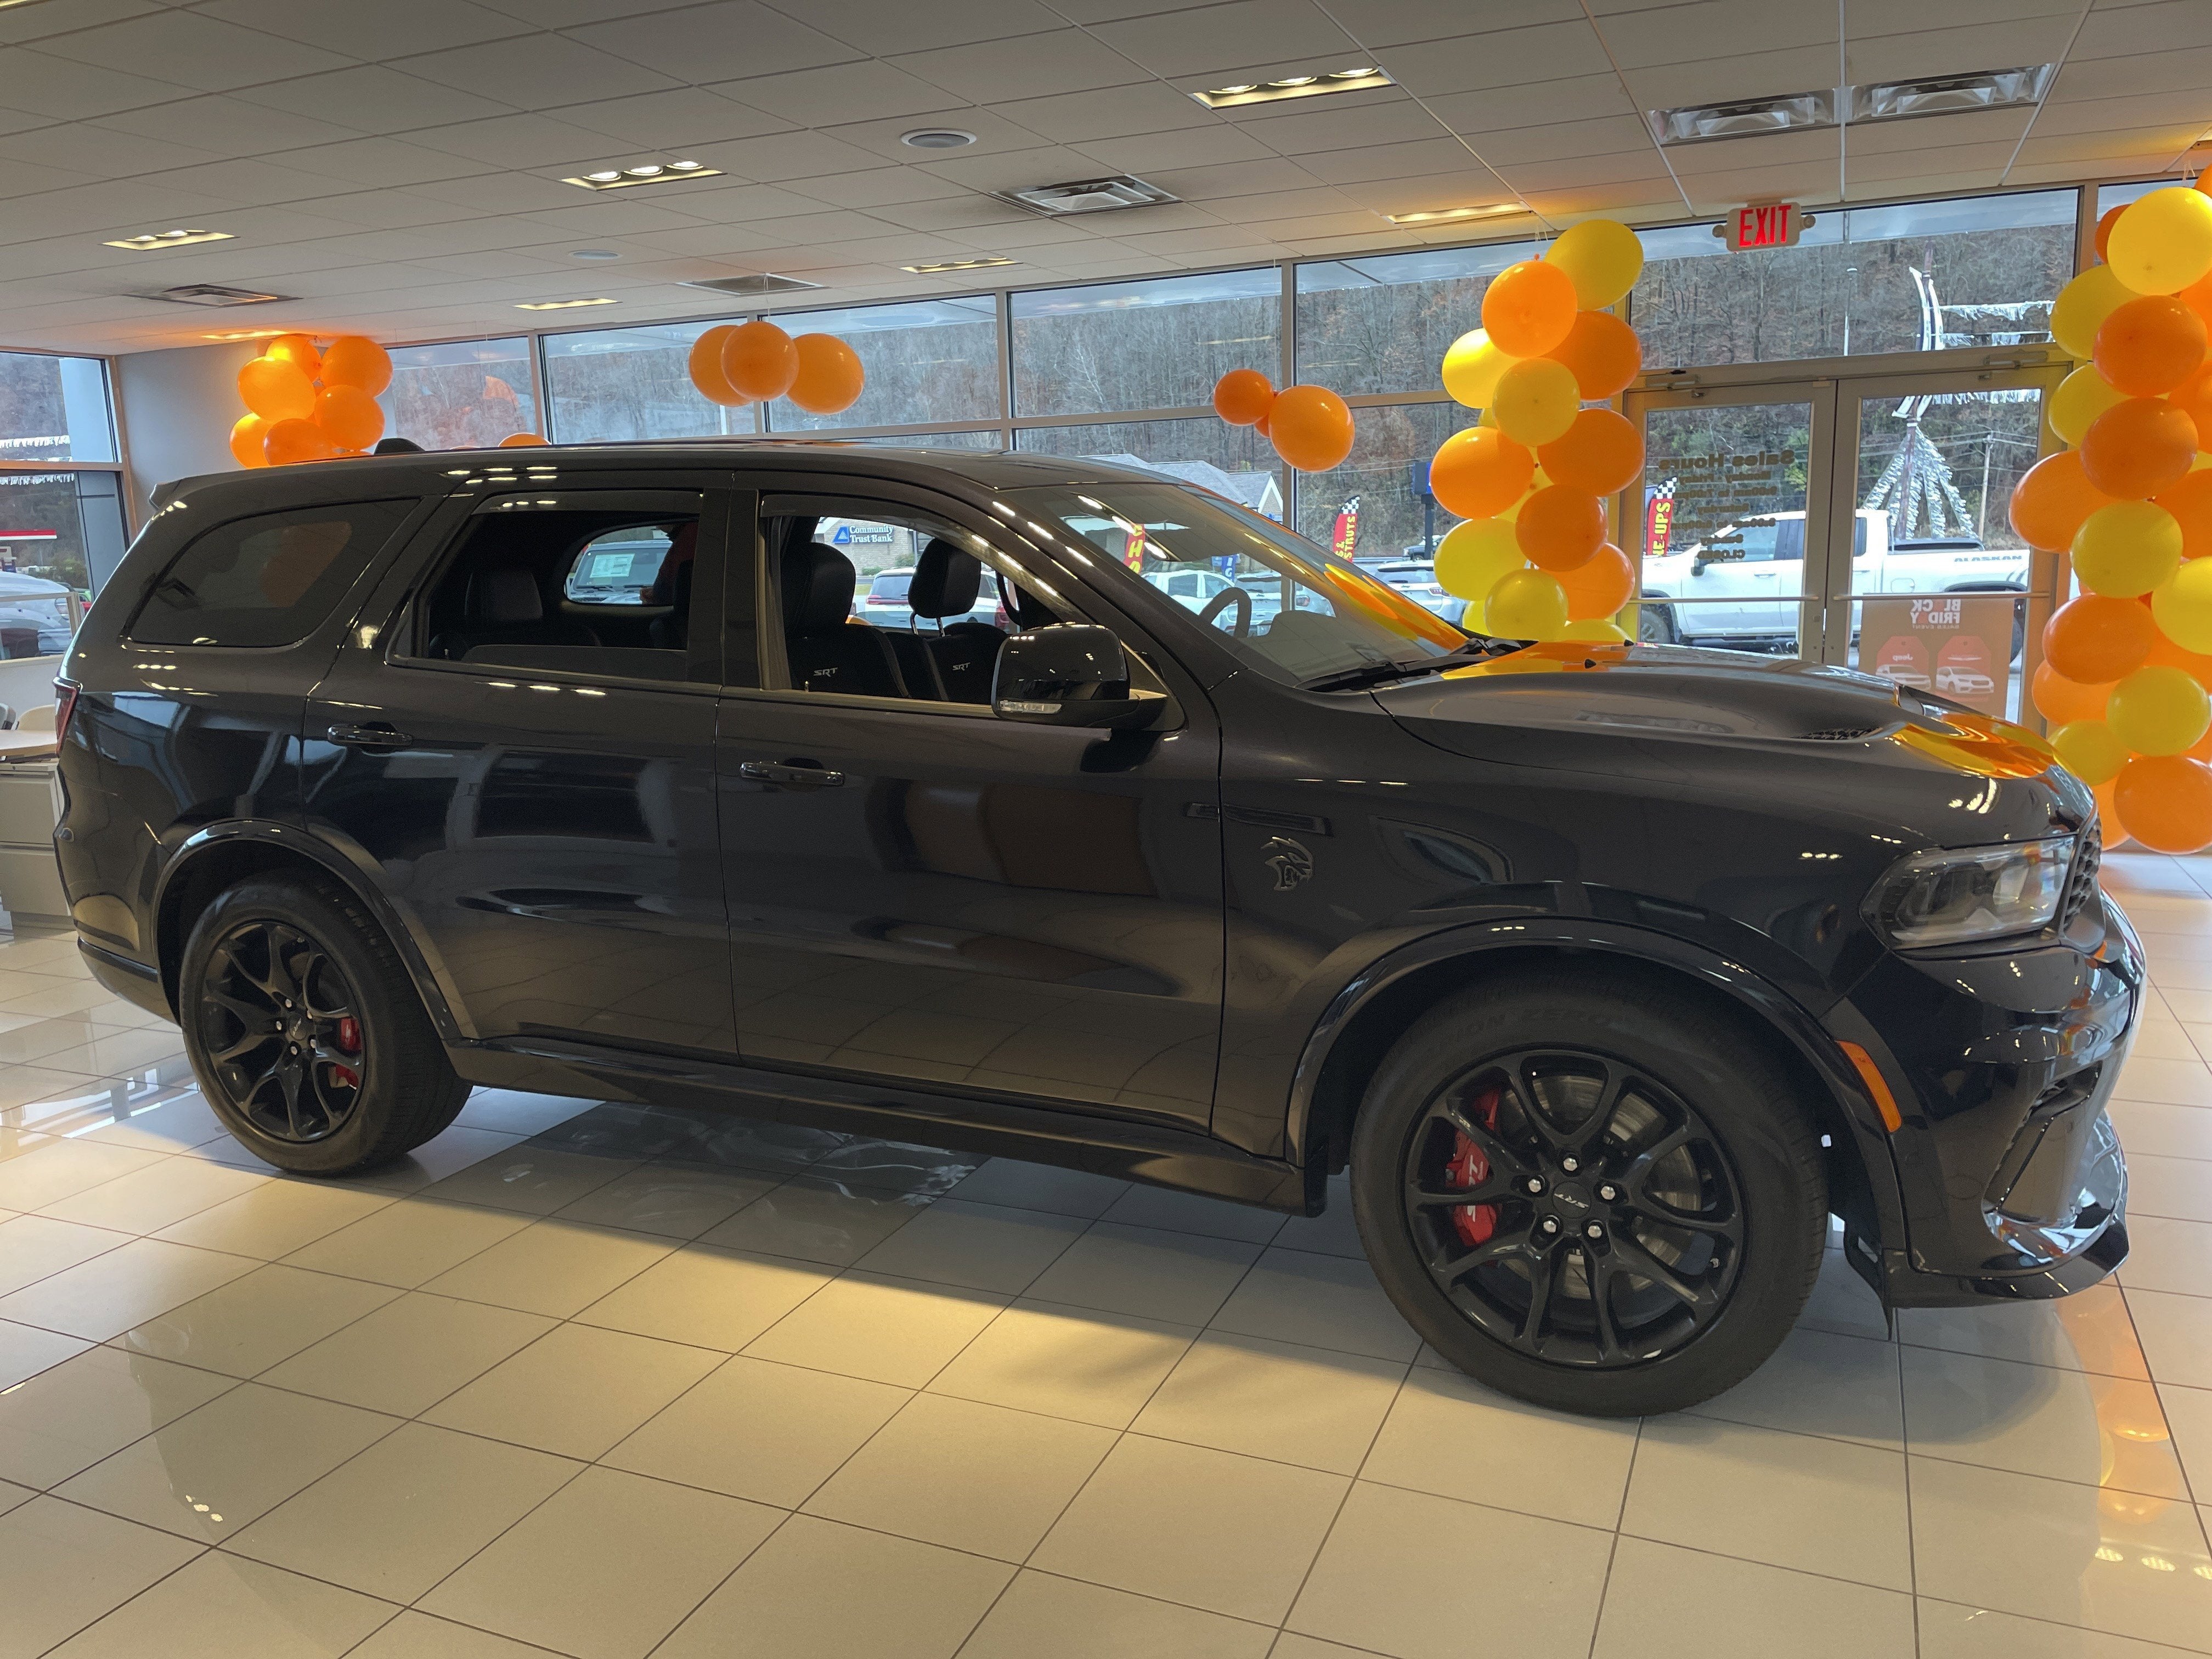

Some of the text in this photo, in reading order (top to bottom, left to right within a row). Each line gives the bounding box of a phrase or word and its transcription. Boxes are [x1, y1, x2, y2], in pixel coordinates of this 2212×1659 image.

[1739, 204, 1792, 247] EXIT
[849, 524, 894, 534] Community
[871, 534, 893, 543] Bank
[1344, 516, 1356, 559] STRUTS
[952, 662, 970, 671] SRT
[814, 667, 838, 677] SRT
[1554, 1193, 1589, 1209] SRT
